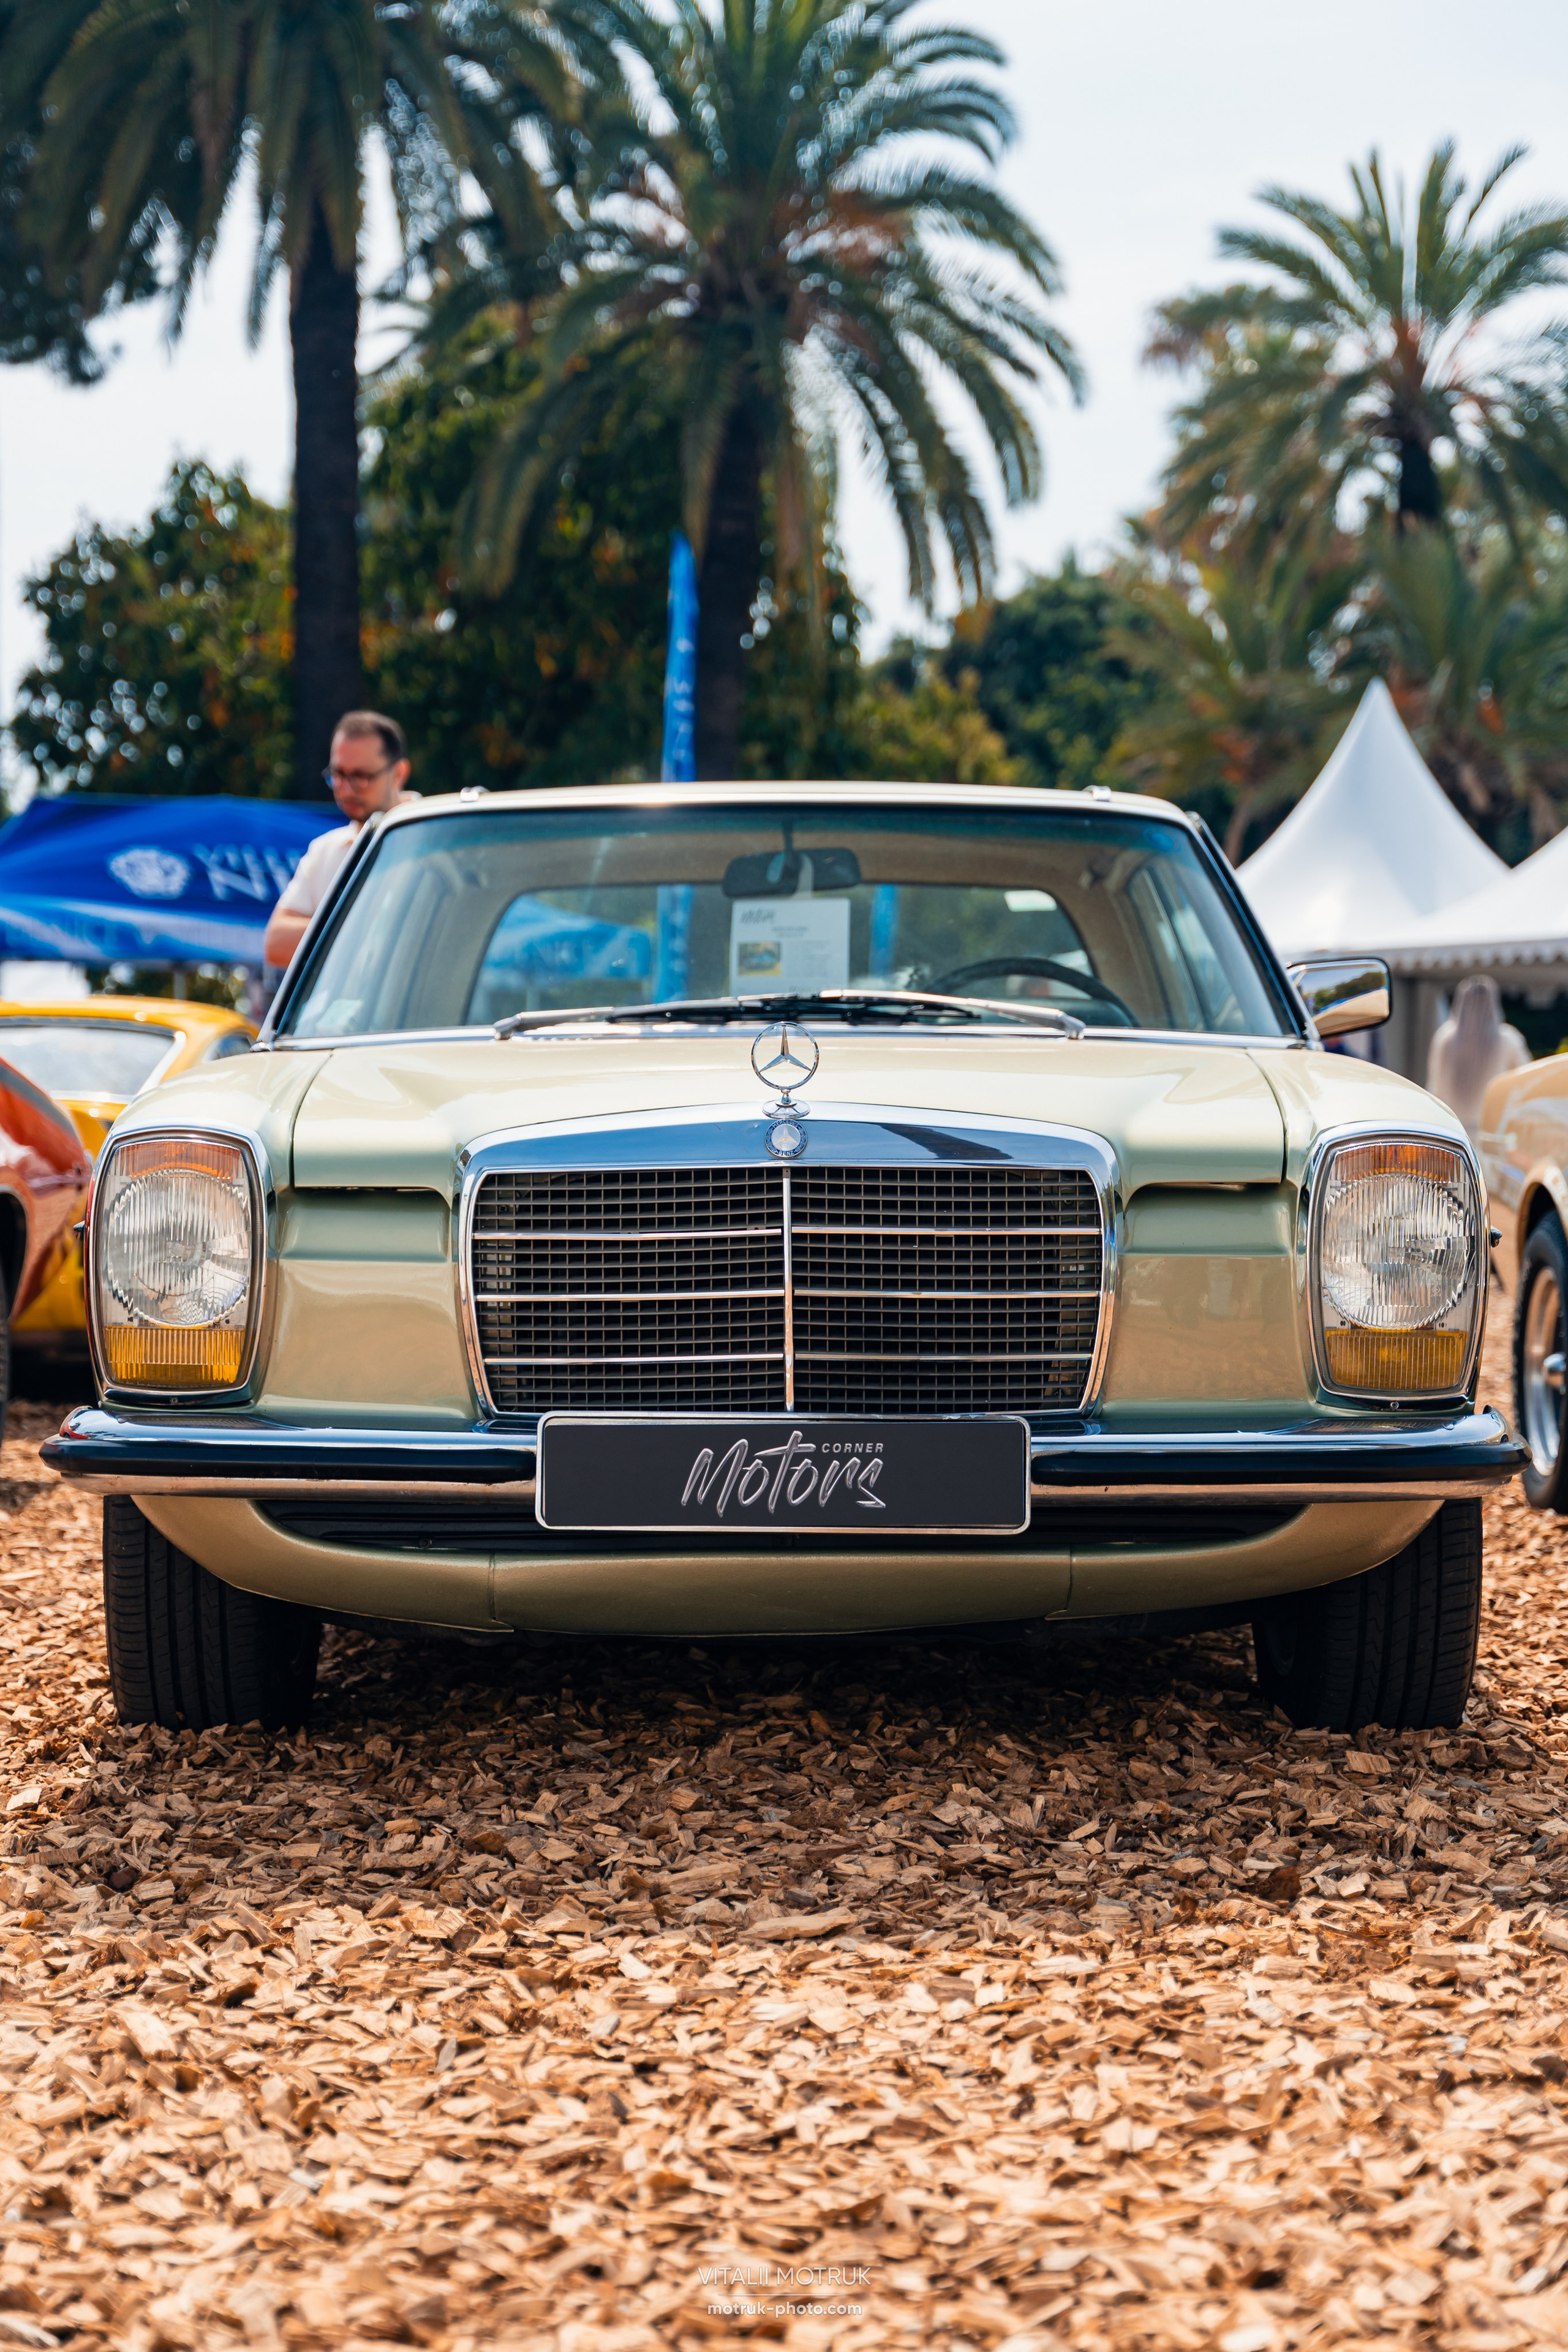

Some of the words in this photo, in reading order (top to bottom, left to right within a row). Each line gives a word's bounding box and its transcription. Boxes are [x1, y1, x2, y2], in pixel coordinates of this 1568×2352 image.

[772, 1119, 799, 1128] MERCEDES
[821, 1442, 884, 1453] CORNER
[681, 1431, 886, 1518] Motors
